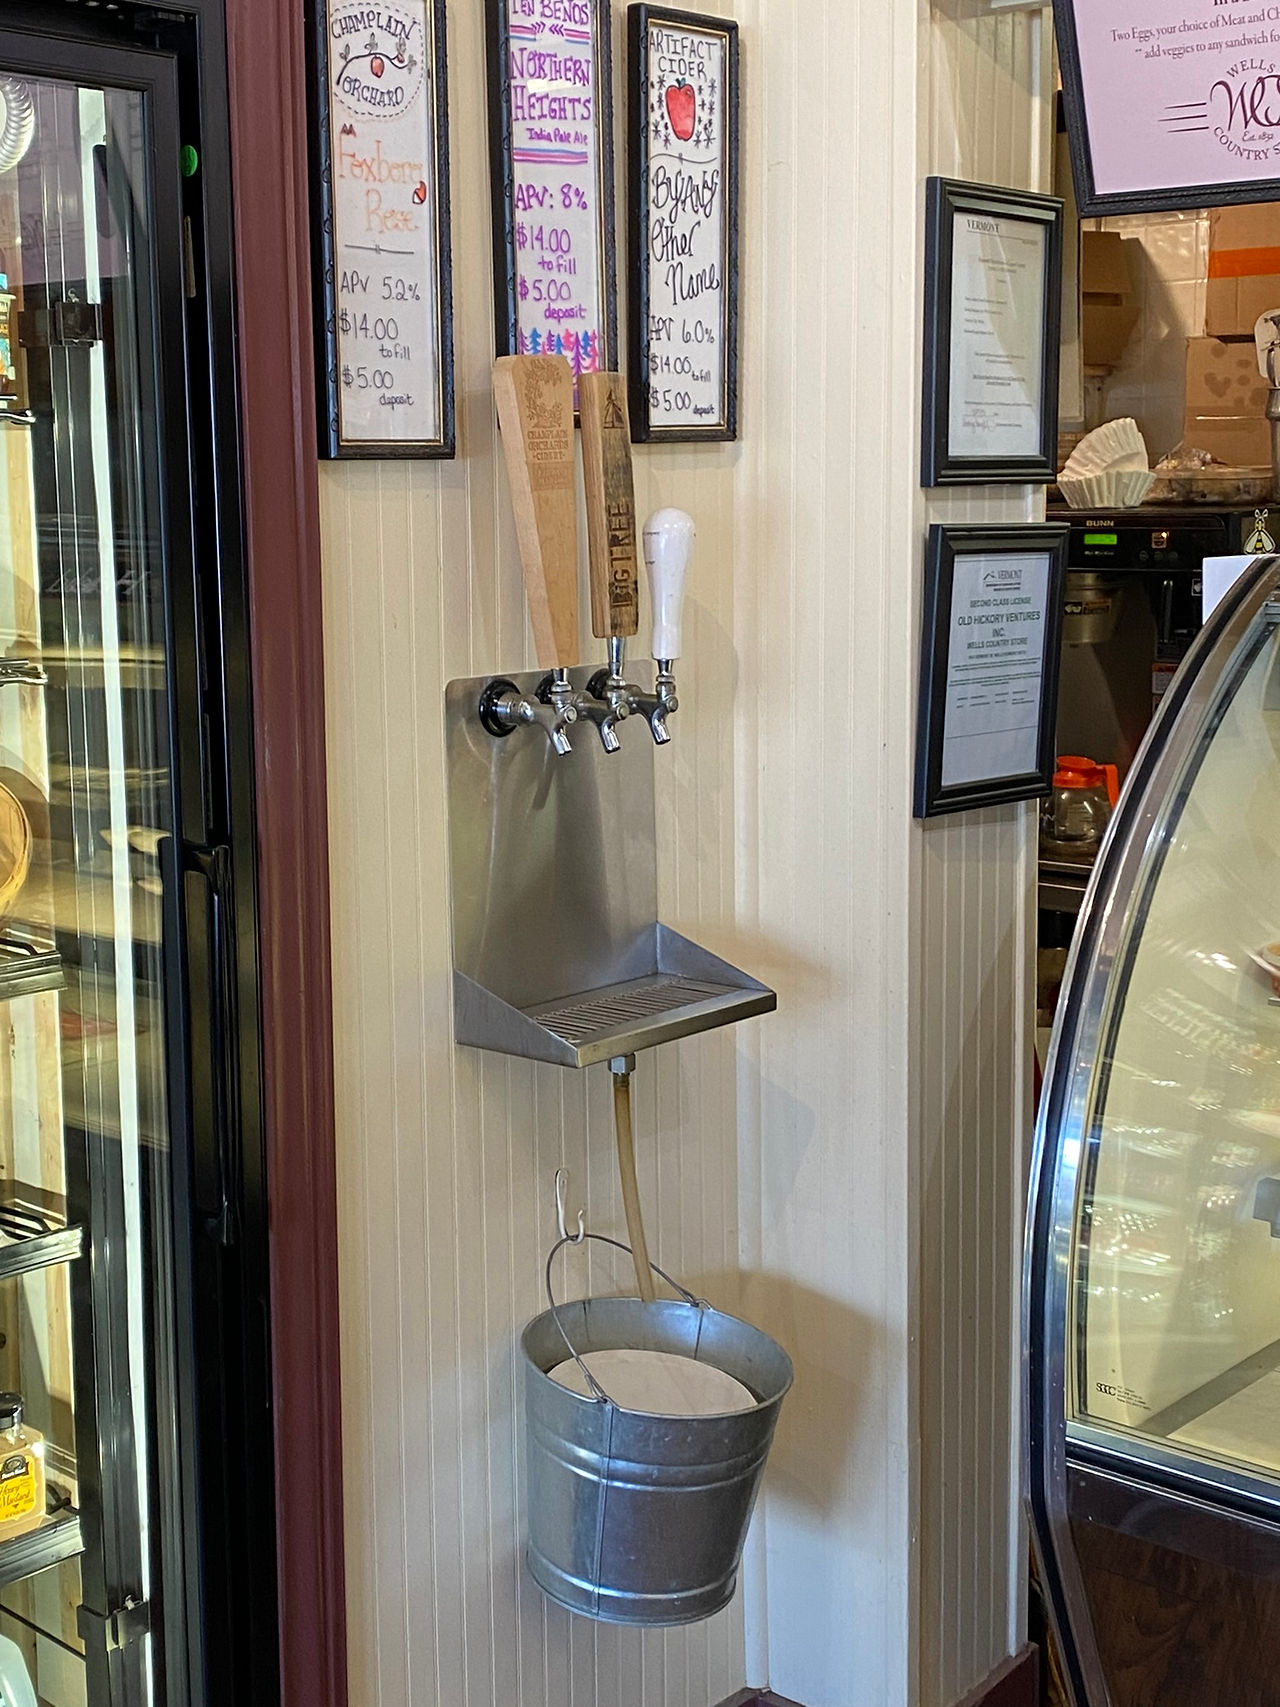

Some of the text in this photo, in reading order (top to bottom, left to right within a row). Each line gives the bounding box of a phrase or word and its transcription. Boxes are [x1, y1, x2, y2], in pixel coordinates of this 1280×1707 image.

[331, 9, 417, 40] CHAMPLAIN
[1110, 29, 1131, 42] Two
[1131, 26, 1156, 43] Eggs,
[1156, 25, 1177, 40] your
[1178, 19, 1208, 33] choice
[1210, 14, 1221, 29] of
[1221, 13, 1246, 27] Meat
[1247, 8, 1265, 24] and
[650, 29, 717, 60] ARTIFACT
[1162, 43, 1195, 59] veggies
[1196, 43, 1206, 52] to
[1207, 40, 1223, 54] any
[1225, 30, 1268, 48] sandwich
[510, 47, 591, 86] NORTHERN
[658, 56, 707, 82] CIDER
[1226, 58, 1276, 78] WELLS
[512, 85, 591, 121] HEIGHTS
[526, 127, 588, 145] India Pale Ale
[1214, 126, 1270, 161] COUNTRY
[560, 183, 588, 211] 8%
[516, 222, 571, 253] $14.00
[967, 218, 1000, 234] VERMONT
[538, 254, 577, 275] to fill
[518, 274, 571, 302] $5.00
[664, 261, 720, 306] Name
[340, 307, 399, 340] $14.00
[544, 303, 587, 325] deposit
[379, 343, 410, 360] to fill
[342, 364, 394, 389] $5.00
[957, 610, 1041, 627] OLD HICKORY VENTURES
